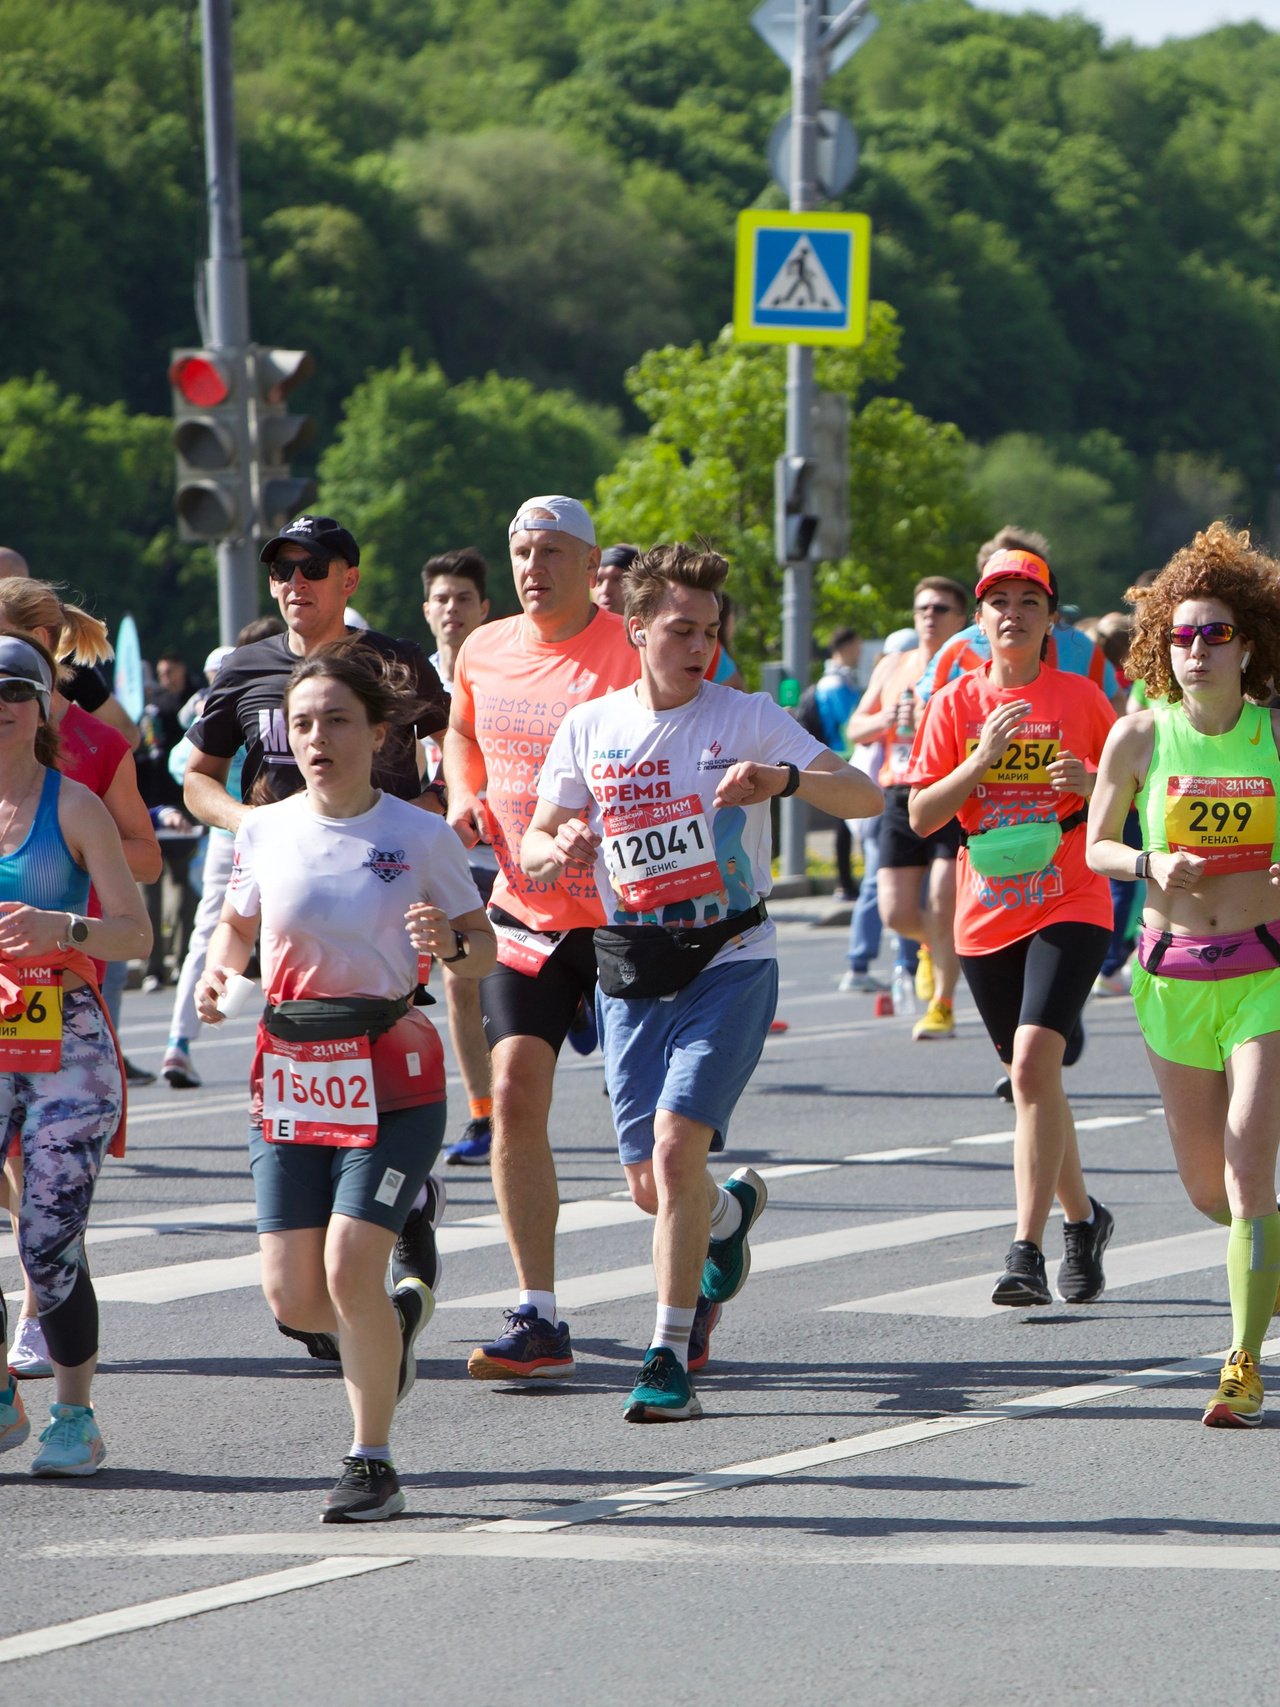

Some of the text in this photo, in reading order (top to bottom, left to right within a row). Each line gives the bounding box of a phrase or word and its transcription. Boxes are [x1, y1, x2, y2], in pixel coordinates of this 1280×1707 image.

[592, 749, 632, 760] ЗАБЕГ
[970, 742, 1058, 771] 254
[591, 759, 671, 780] САМОЕ
[997, 773, 1029, 781] МАРИЯ
[592, 780, 672, 803] ВРЕМЯ
[1189, 801, 1253, 833] 299
[612, 820, 705, 870] 12041
[1200, 835, 1240, 845] РЕНАТА
[645, 860, 679, 877] ДЕНИС
[627, 884, 640, 902] E
[979, 886, 1044, 910] ФОН
[0, 1026, 18, 1037] ИЯ
[271, 1068, 371, 1110] 15602
[278, 1119, 291, 1138] E
